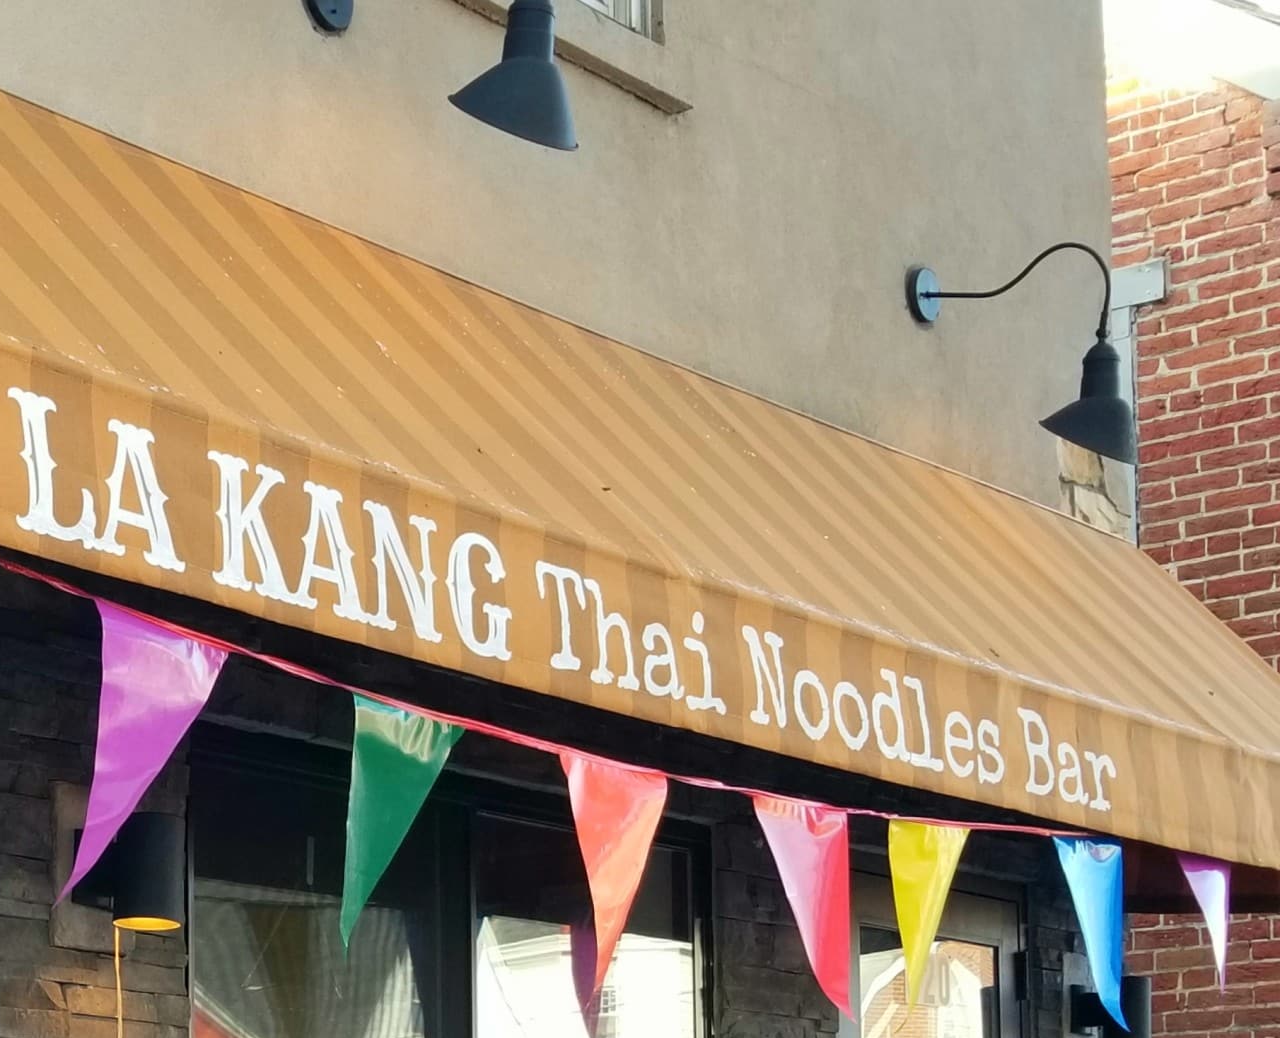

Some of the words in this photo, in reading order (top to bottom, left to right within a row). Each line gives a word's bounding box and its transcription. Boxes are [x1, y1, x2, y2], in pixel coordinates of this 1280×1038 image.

[7, 386, 187, 573] LA
[207, 450, 513, 662] KANG
[534, 559, 727, 716] Thai
[741, 624, 1007, 785] Noodles
[1016, 706, 1118, 812] Bar
